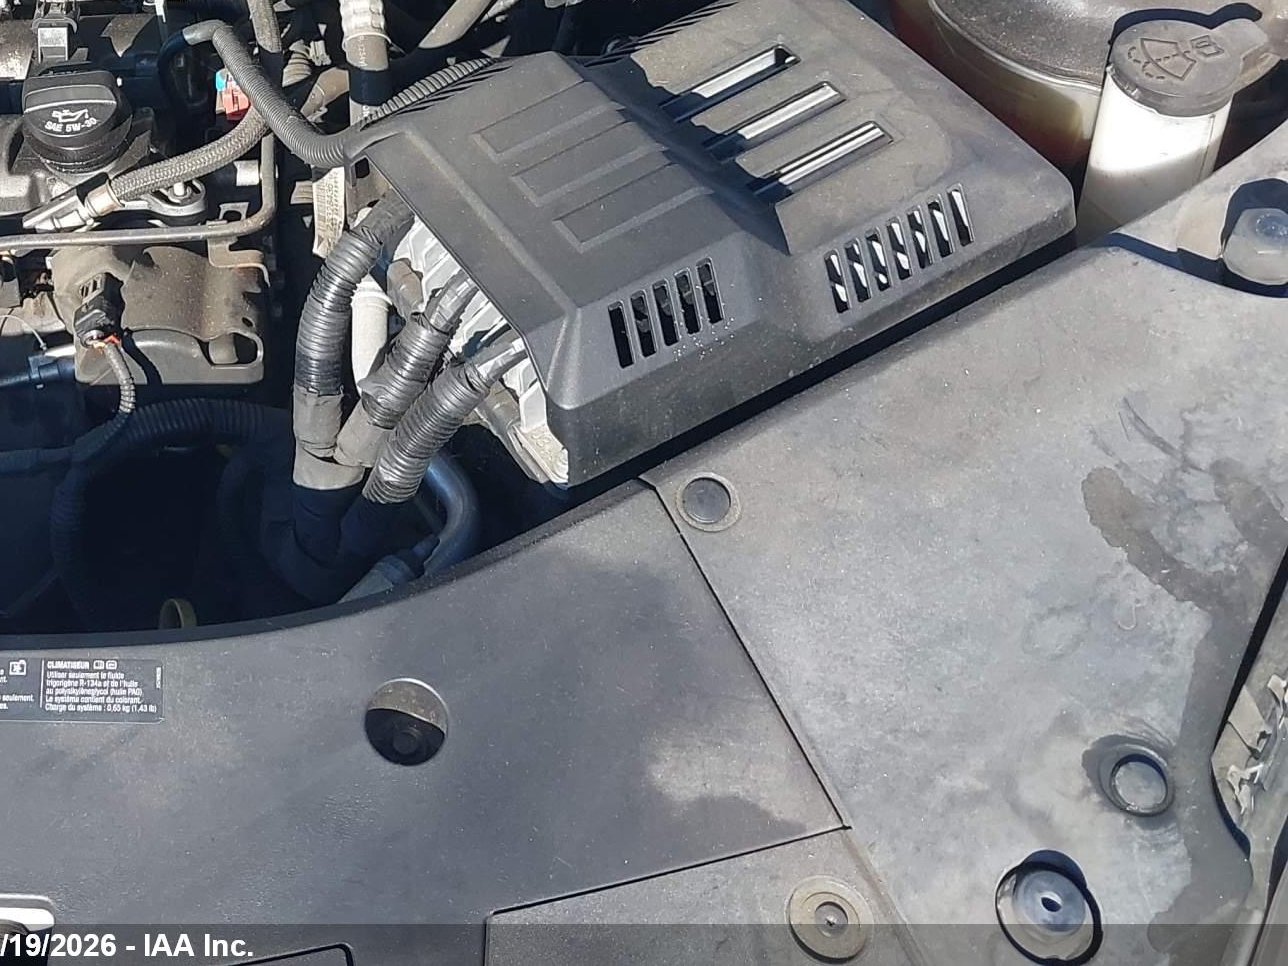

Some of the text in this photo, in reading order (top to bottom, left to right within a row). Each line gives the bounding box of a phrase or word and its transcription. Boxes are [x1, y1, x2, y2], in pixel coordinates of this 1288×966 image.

[45, 117, 98, 132] SAE 5W-30
[47, 660, 90, 669] CLIMATISEUR
[46, 671, 67, 679] Utiliser
[79, 679, 102, 687] R-134a
[110, 680, 119, 688] de
[45, 694, 53, 703] Le
[54, 696, 79, 704] système
[80, 696, 105, 704] contient
[105, 696, 115, 704] du
[45, 703, 67, 713] Charge
[67, 703, 76, 711] du
[76, 704, 103, 712] système
[121, 704, 130, 713] kg
